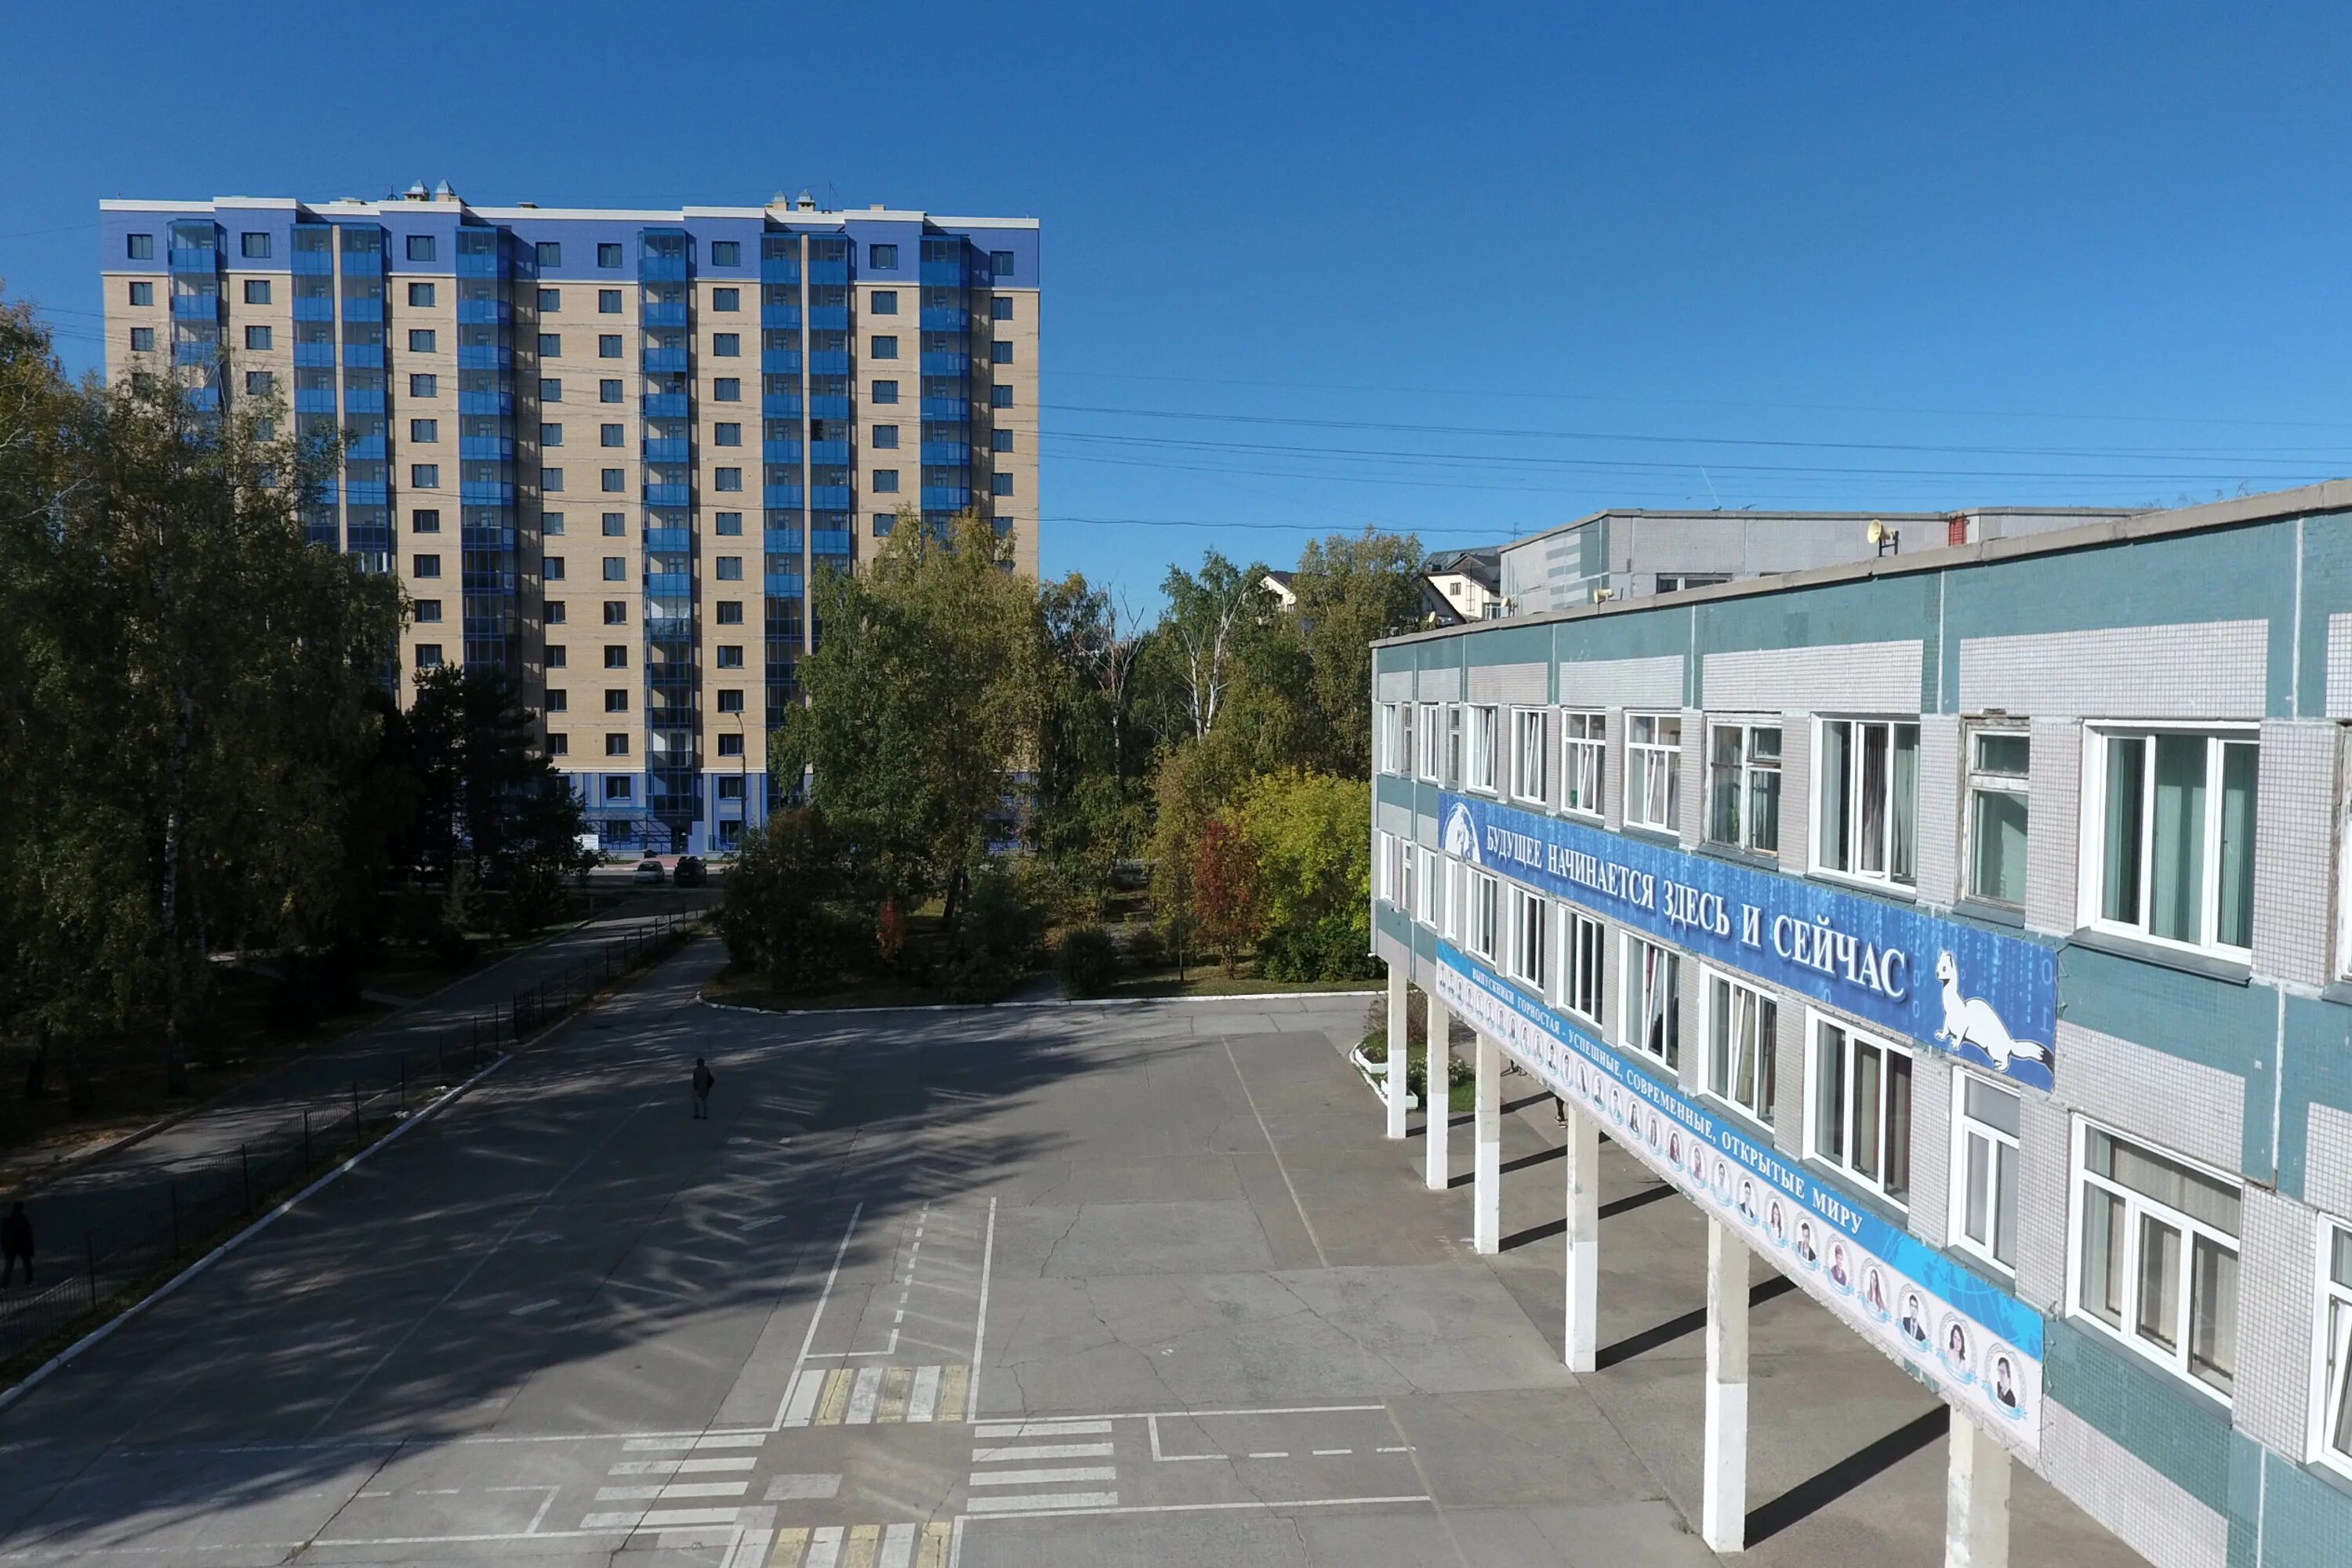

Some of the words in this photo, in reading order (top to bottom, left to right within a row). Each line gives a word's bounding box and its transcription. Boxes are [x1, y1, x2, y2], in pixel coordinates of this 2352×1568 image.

[1486, 825, 1542, 870] БУДУЩЕЕ
[1548, 844, 1655, 910] НАЧИНАЕТСЯ
[1663, 880, 1731, 935] ЗДЕСЬ
[1740, 903, 1762, 948] И
[1773, 914, 1907, 998] СЕЙЧАС
[1472, 967, 1514, 1005] ВЫПУСКНИКИ
[1517, 998, 1559, 1035] ГОРНОСТАЯ
[1568, 1030, 1623, 1081] УСПЕШНЫЕ,
[1627, 1069, 1716, 1144] СОВРЕМЕННЫЕ,
[1722, 1131, 1805, 1200] ОТКРЫТЫЕ
[1812, 1186, 1864, 1234] МИРУ
